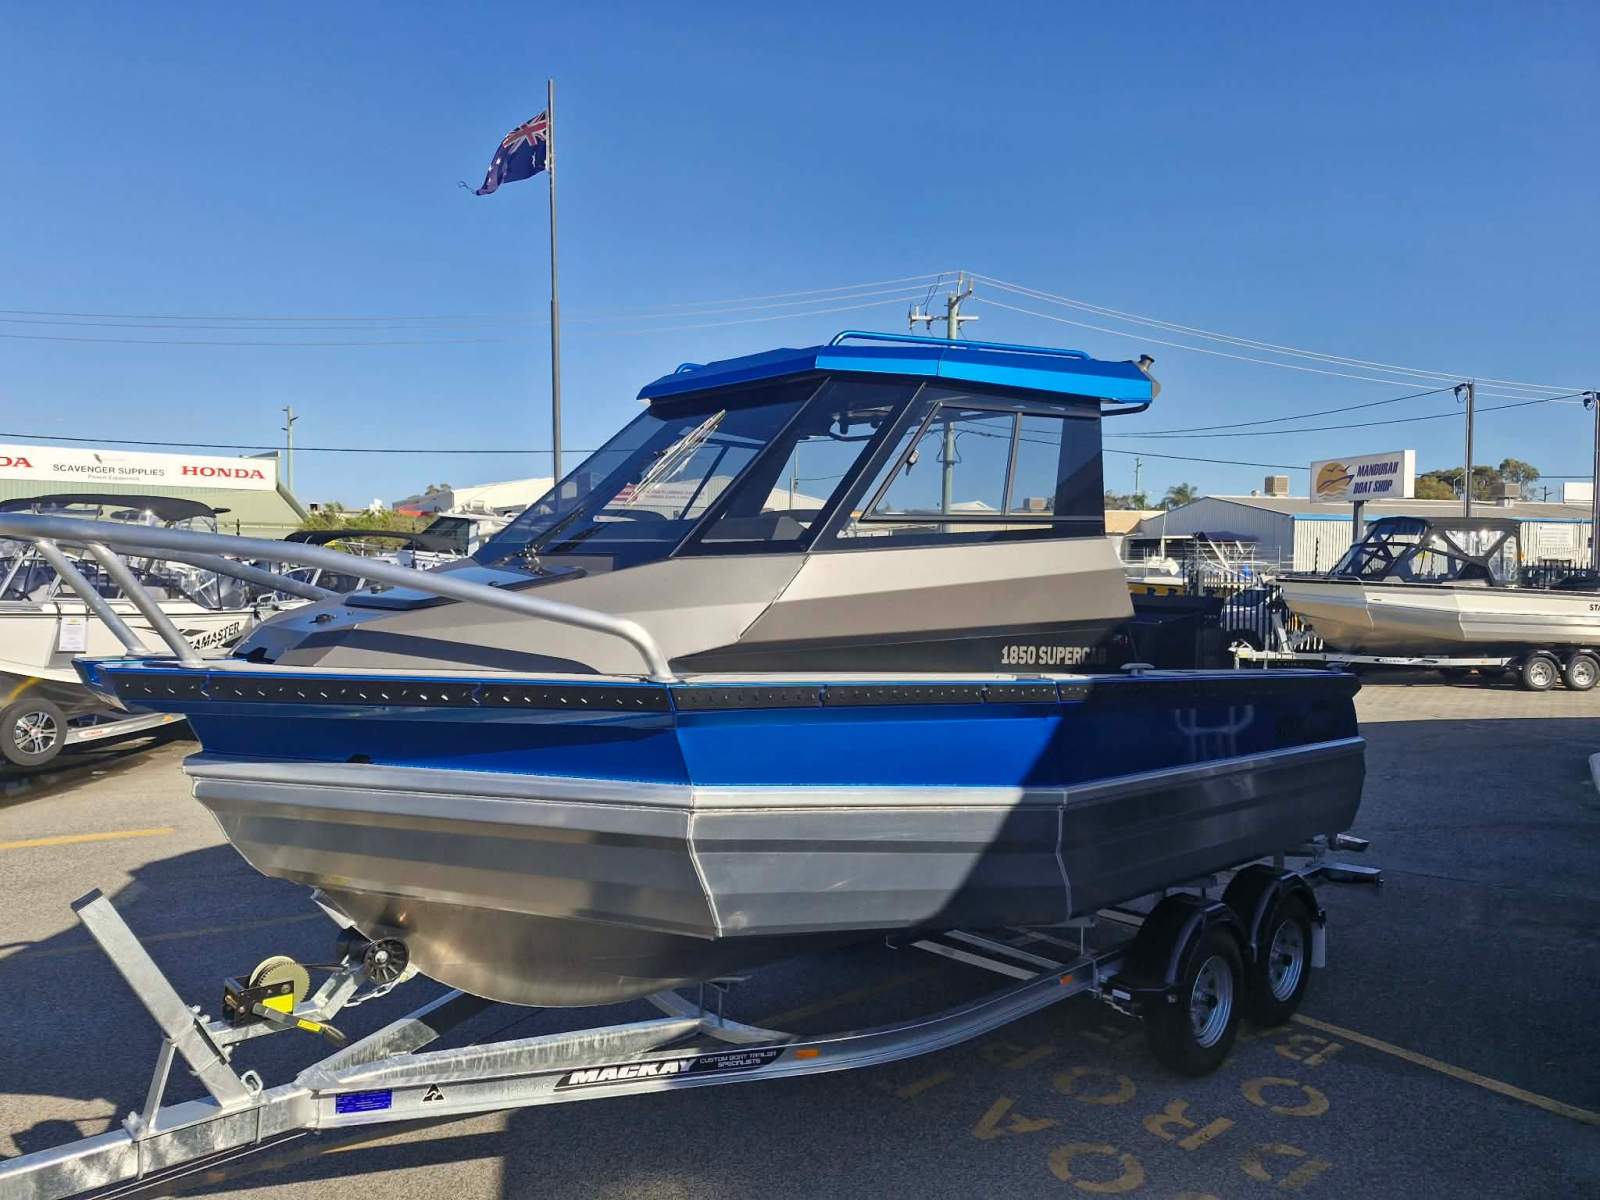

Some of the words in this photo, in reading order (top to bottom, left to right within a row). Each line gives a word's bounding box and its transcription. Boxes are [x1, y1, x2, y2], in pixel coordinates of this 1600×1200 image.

[53, 464, 115, 474] SCAVENGER
[118, 468, 165, 476] SUPPLIES
[181, 465, 265, 479] HONDA
[1357, 462, 1399, 477] MANDURAH
[1353, 481, 1373, 494] BOAT
[1374, 480, 1393, 492] SHOP
[1001, 645, 1036, 664] 1850
[568, 1057, 697, 1085] MACKAY
